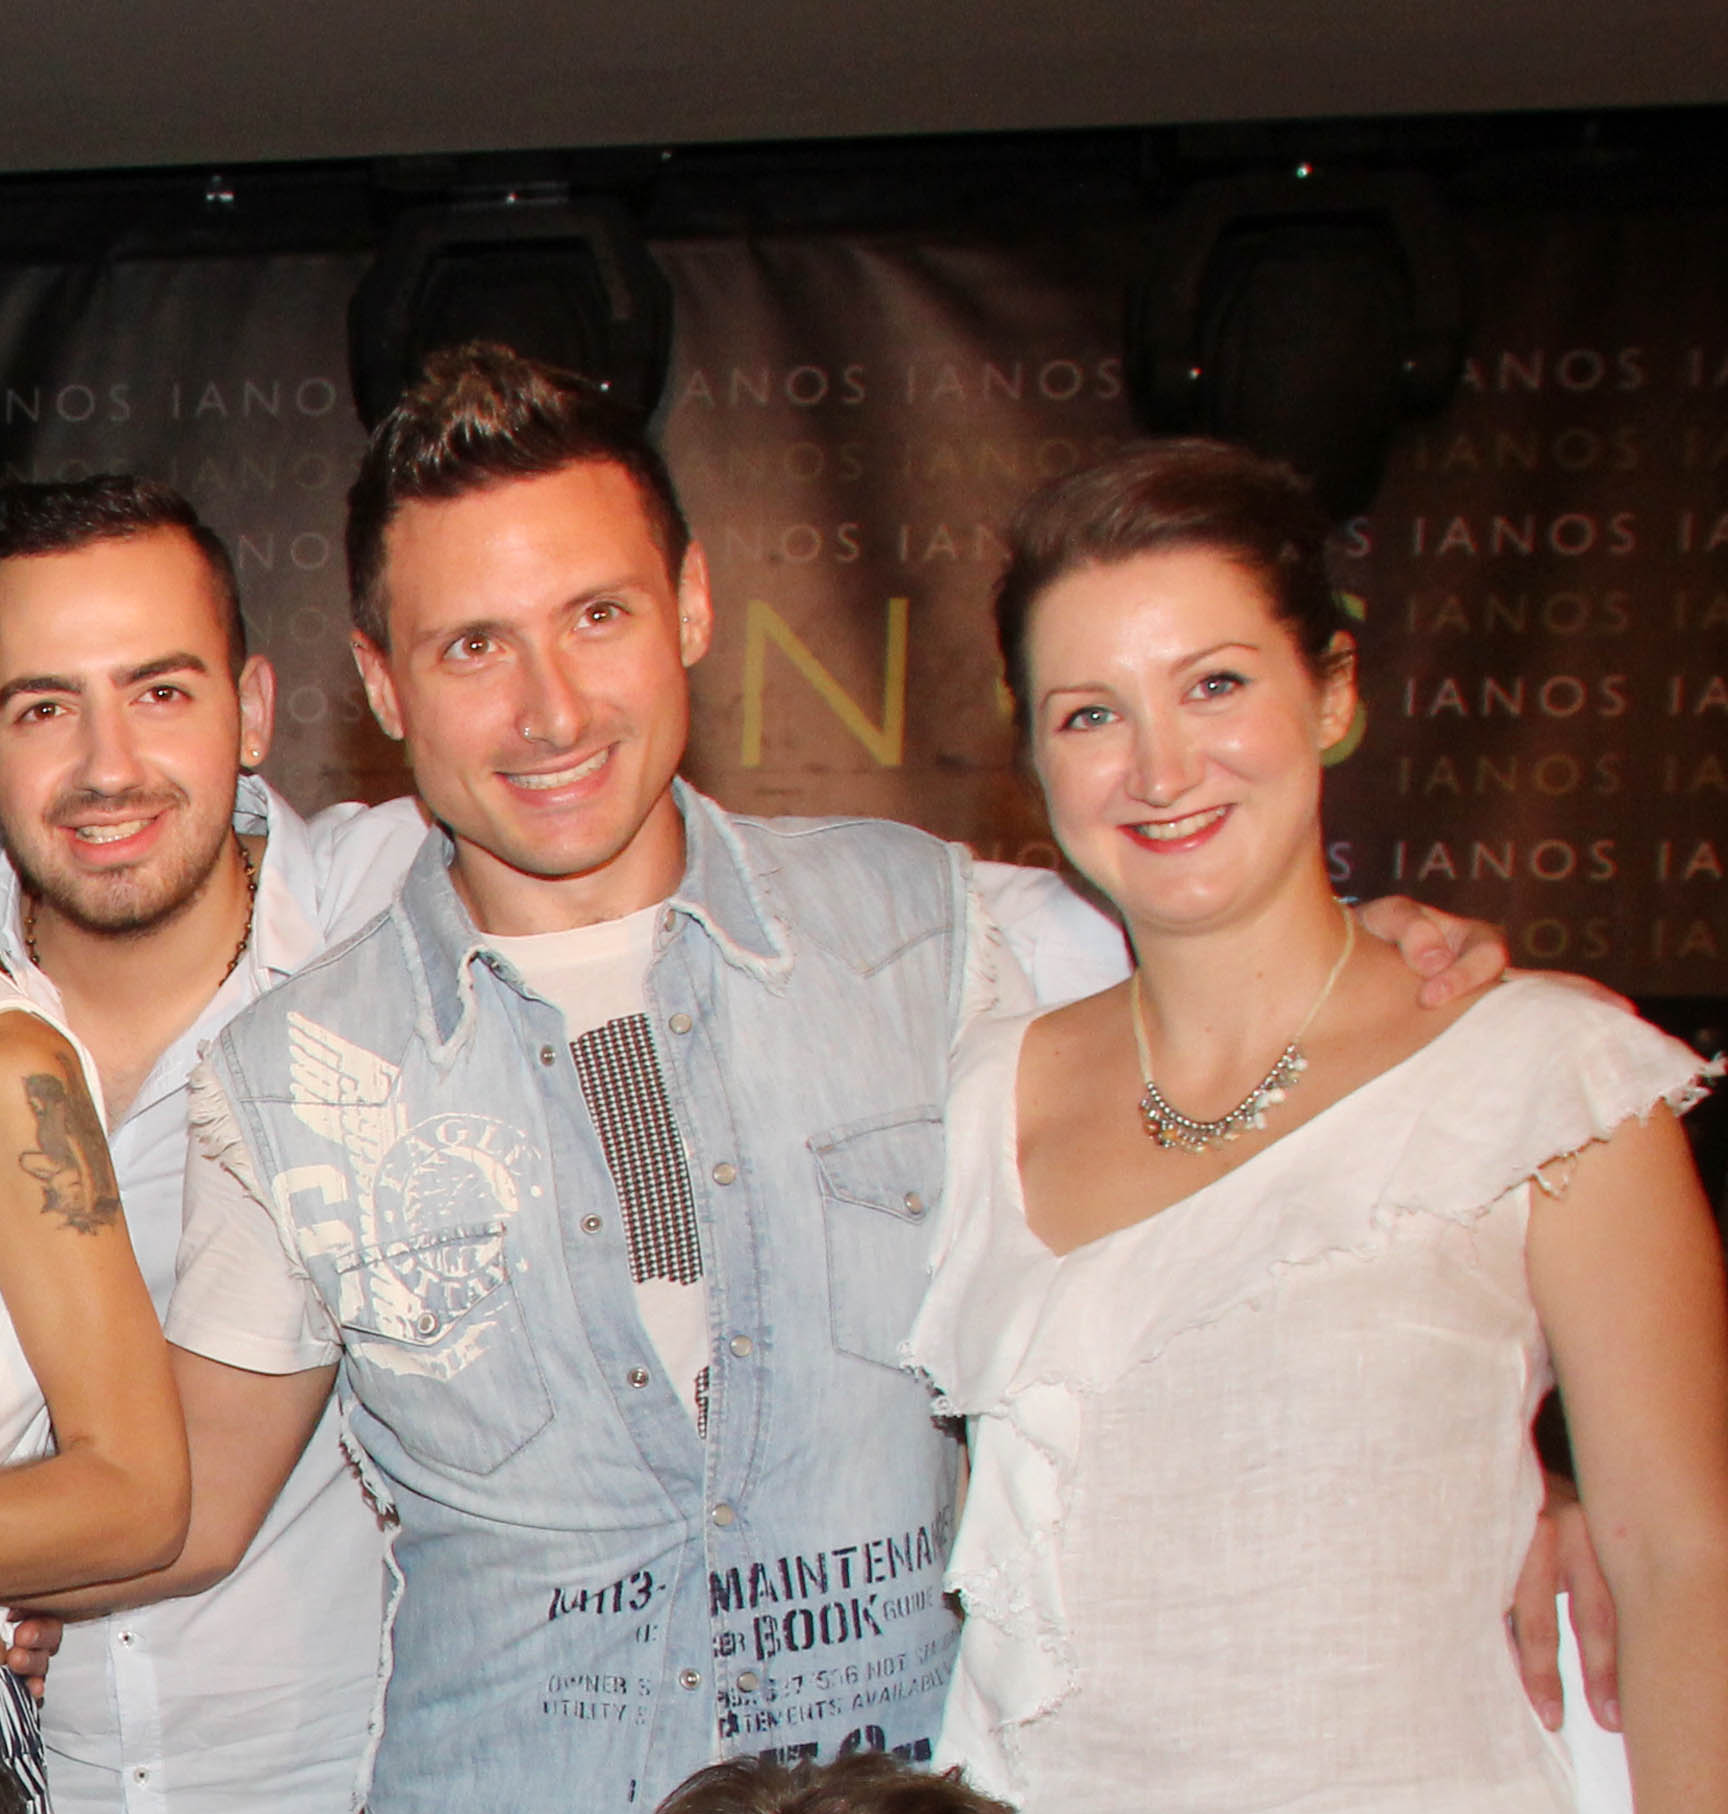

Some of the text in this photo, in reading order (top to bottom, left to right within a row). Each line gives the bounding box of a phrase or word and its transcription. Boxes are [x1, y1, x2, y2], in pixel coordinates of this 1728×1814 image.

[171, 375, 338, 421] IANO
[680, 357, 1123, 409] ANOS IANOS
[1410, 511, 1639, 558] IANOS
[1404, 673, 1629, 720] IANOS
[1397, 751, 1622, 797] IANOS
[1392, 837, 1619, 883] IANOS
[752, 1593, 884, 1662] BOOK
